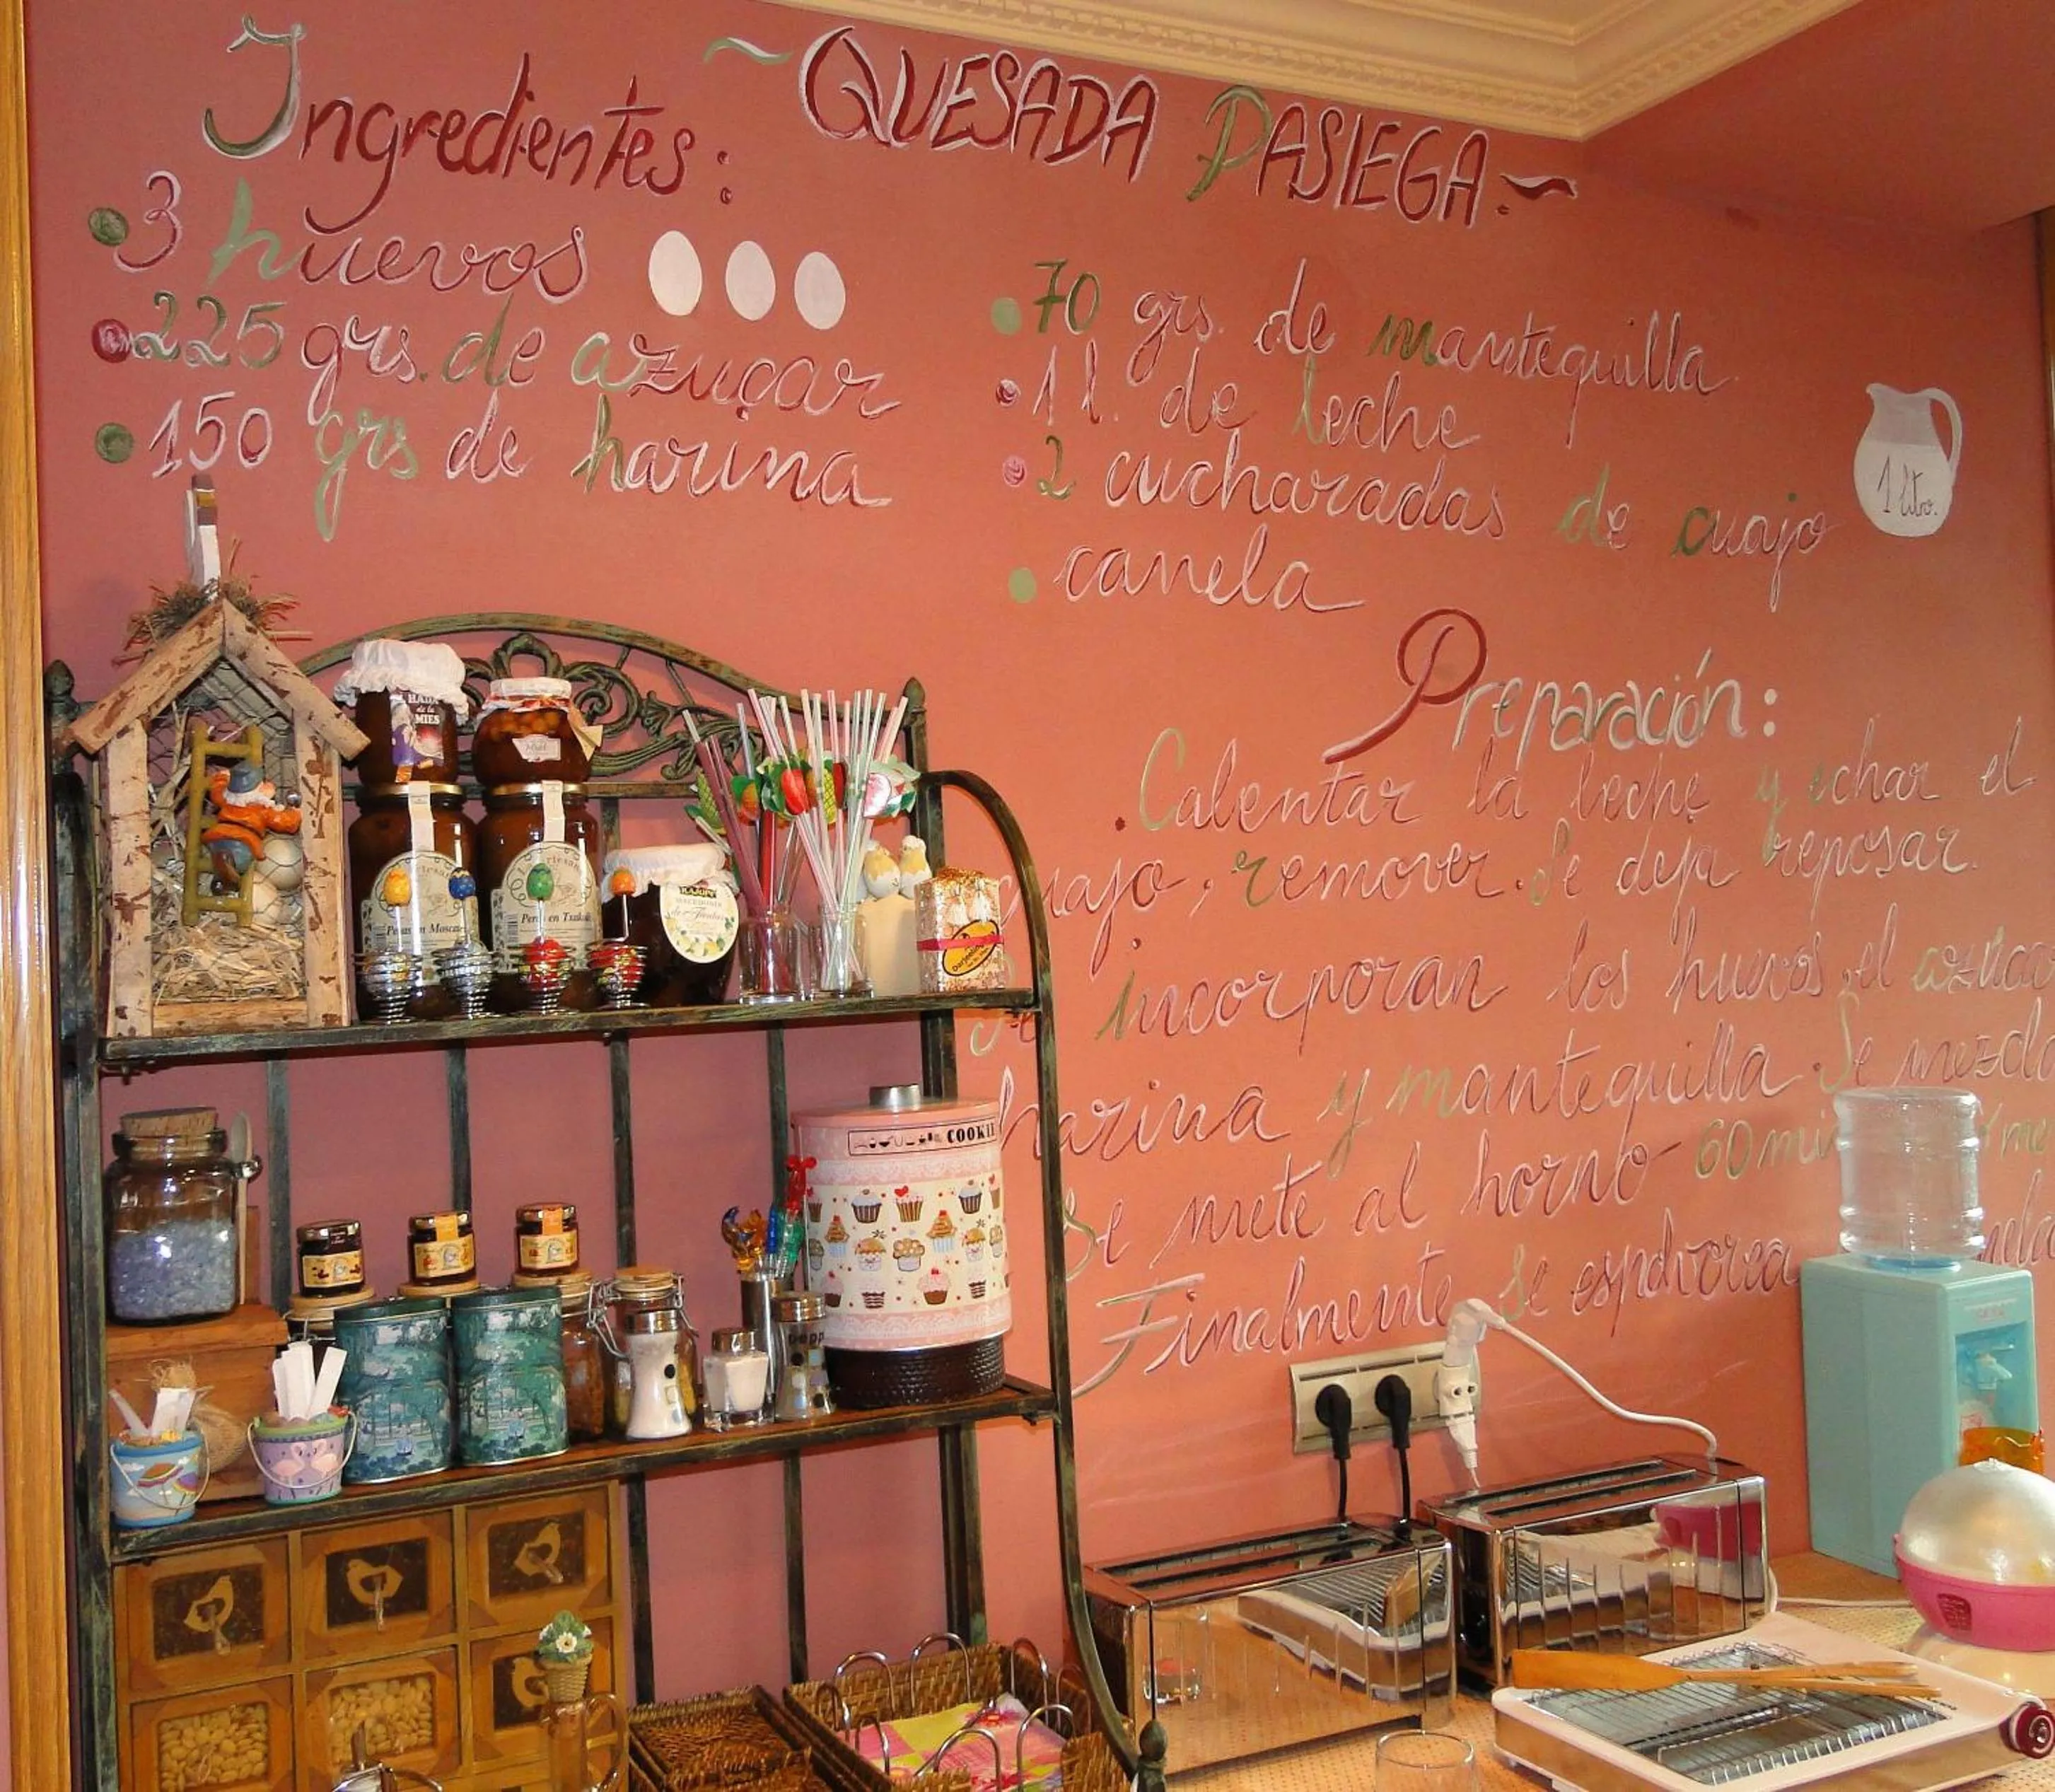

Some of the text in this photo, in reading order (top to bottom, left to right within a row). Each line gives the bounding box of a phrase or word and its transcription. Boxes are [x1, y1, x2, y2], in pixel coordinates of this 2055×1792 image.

[798, 25, 1160, 184] QUESADA
[115, 170, 588, 304] 3 huevos
[133, 290, 287, 371] 225
[441, 292, 545, 388] de
[1033, 258, 1102, 335] 70
[1254, 258, 1335, 356] de
[149, 385, 892, 542] 150 grs de harina
[1160, 347, 1259, 436] de
[1293, 351, 1483, 454] leche
[1035, 426, 1840, 614] 2 cucharadas de cuajo
[1876, 455, 1892, 514] 1
[1052, 523, 1365, 614] canela
[414, 714, 440, 725] MIES
[1321, 607, 1779, 772] Preparación:
[1139, 727, 1424, 836] Calentar
[1467, 733, 1530, 822] la
[1570, 748, 1711, 824] leche
[1805, 716, 1942, 808] echar
[1979, 716, 2038, 798] el
[1617, 813, 1743, 946] deja
[1095, 935, 1510, 1062] incorporan
[1546, 919, 1632, 1014] los
[1854, 902, 1904, 990] el
[1911, 925, 2055, 994] azuca
[999, 1065, 1292, 1162] harina
[1315, 1065, 1372, 1182] y
[1148, 1151, 1327, 1269] mete
[1351, 1139, 1428, 1239] al
[1069, 1240, 1454, 1400] Finalmente
